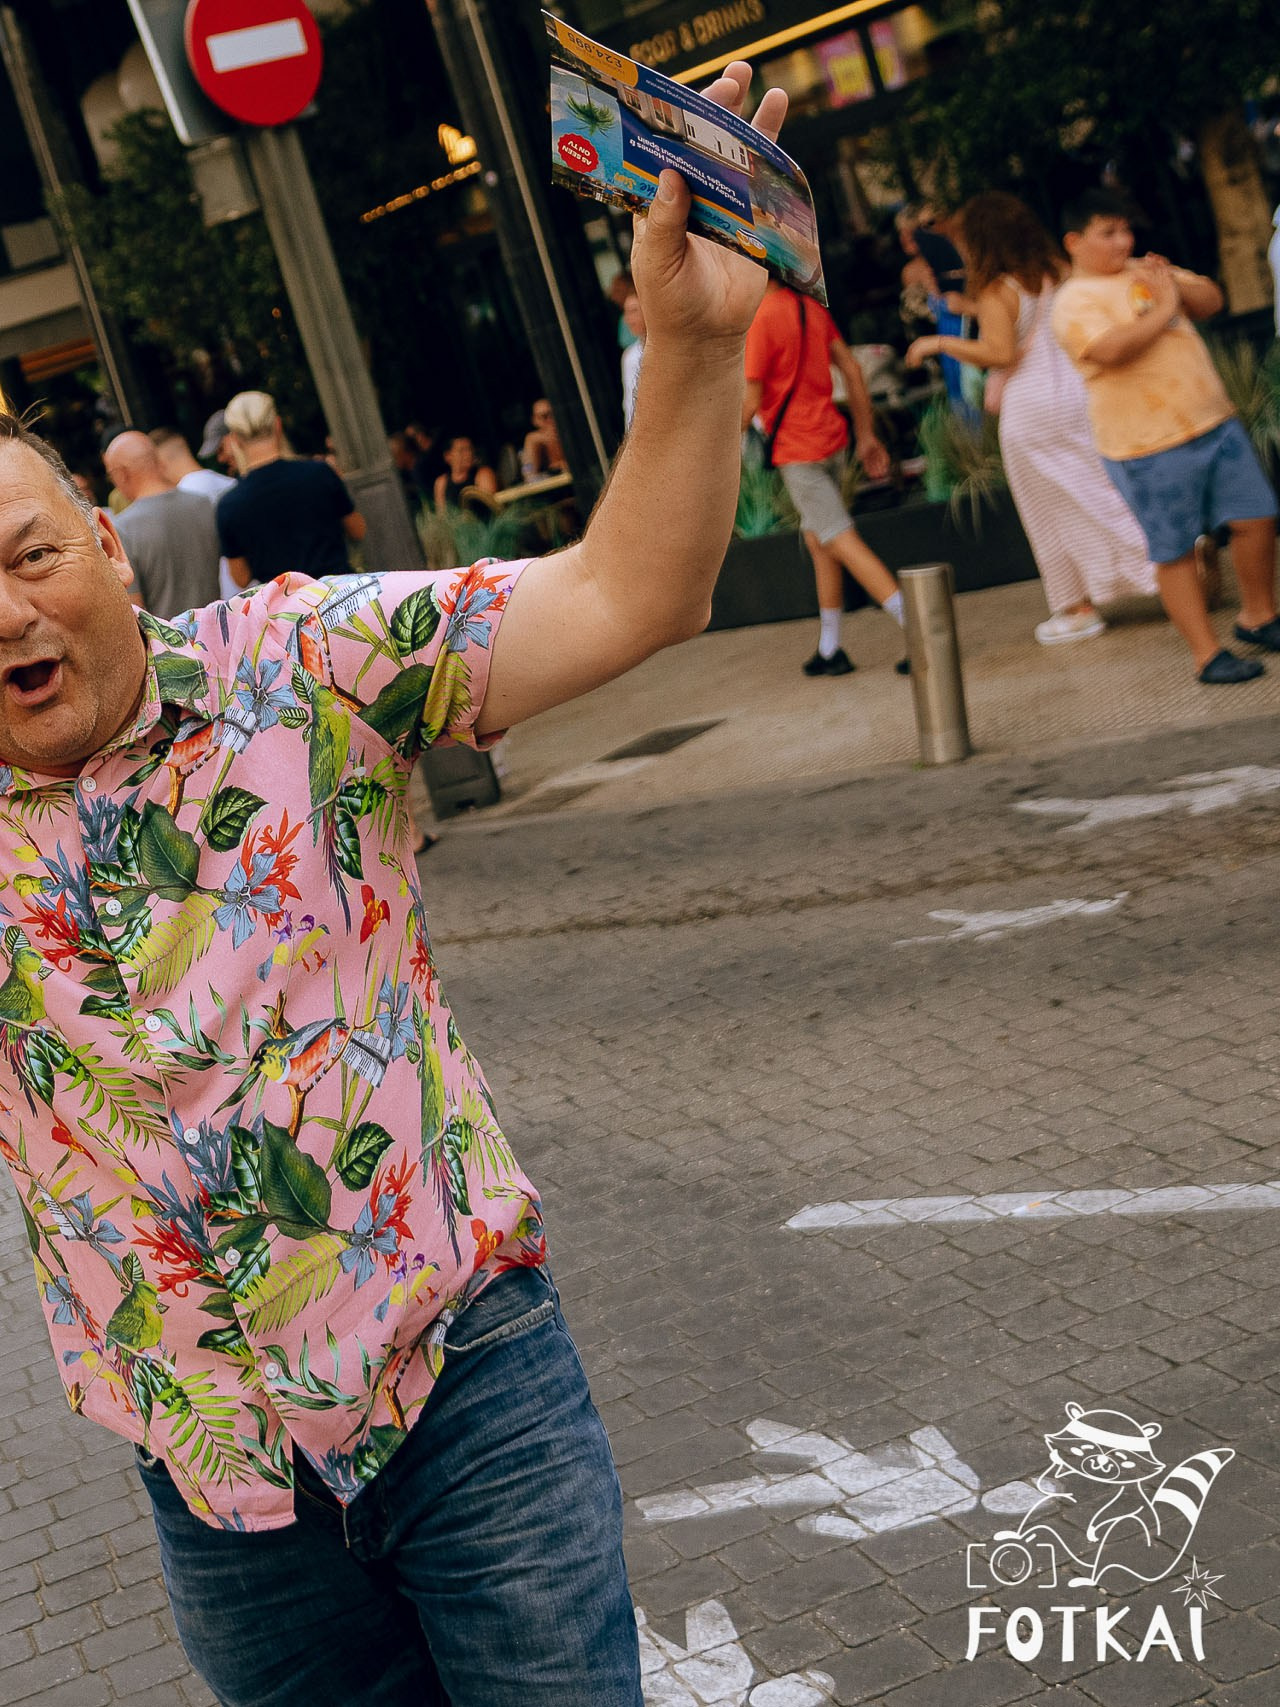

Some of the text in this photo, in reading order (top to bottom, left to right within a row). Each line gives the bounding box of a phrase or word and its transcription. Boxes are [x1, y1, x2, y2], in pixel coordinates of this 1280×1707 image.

[693, 0, 765, 46] DRINKS
[562, 145, 592, 166] AS SEEN
[567, 140, 591, 157] ON TV
[636, 142, 665, 161] Homes
[637, 135, 736, 197] Lodges Throughout Spain
[666, 156, 708, 186] Residential
[715, 186, 745, 208] Holiday
